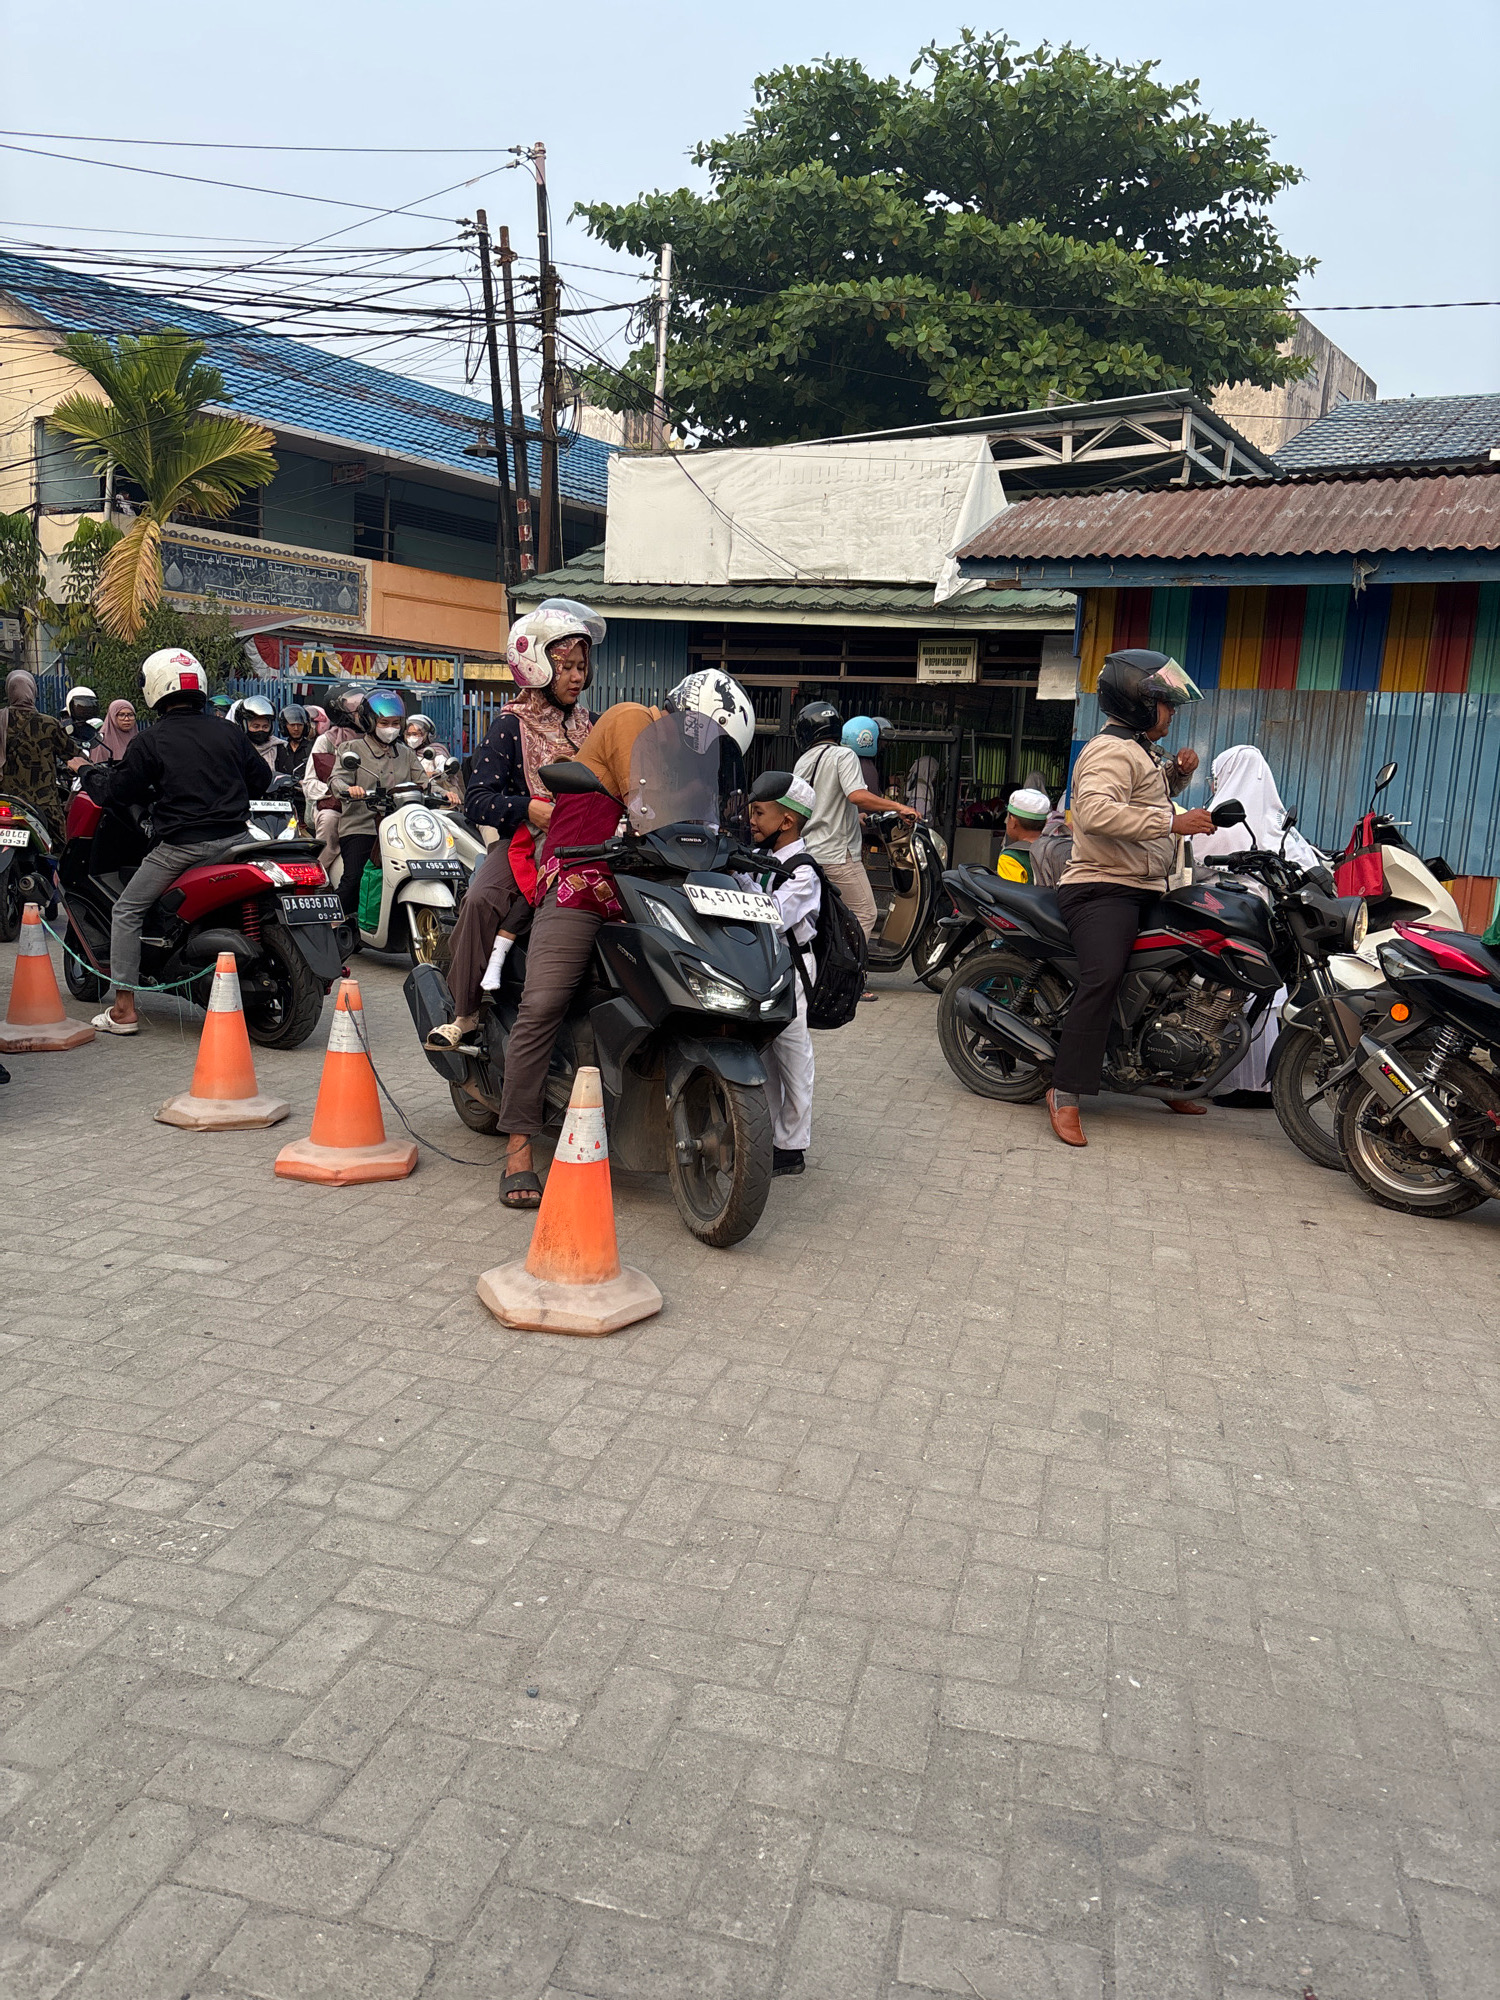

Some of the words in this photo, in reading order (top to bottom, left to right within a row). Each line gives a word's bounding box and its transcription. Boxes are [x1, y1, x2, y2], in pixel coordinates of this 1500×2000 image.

[297, 651, 343, 676] MTS
[351, 654, 380, 678] AL
[387, 656, 452, 682] HAMID
[284, 898, 298, 910] DA
[299, 897, 322, 909] 6836
[323, 896, 340, 910] ADY
[688, 886, 709, 901] DA
[715, 890, 750, 906] 5114
[754, 896, 775, 909] CM
[1147, 1046, 1174, 1055] HONDA
